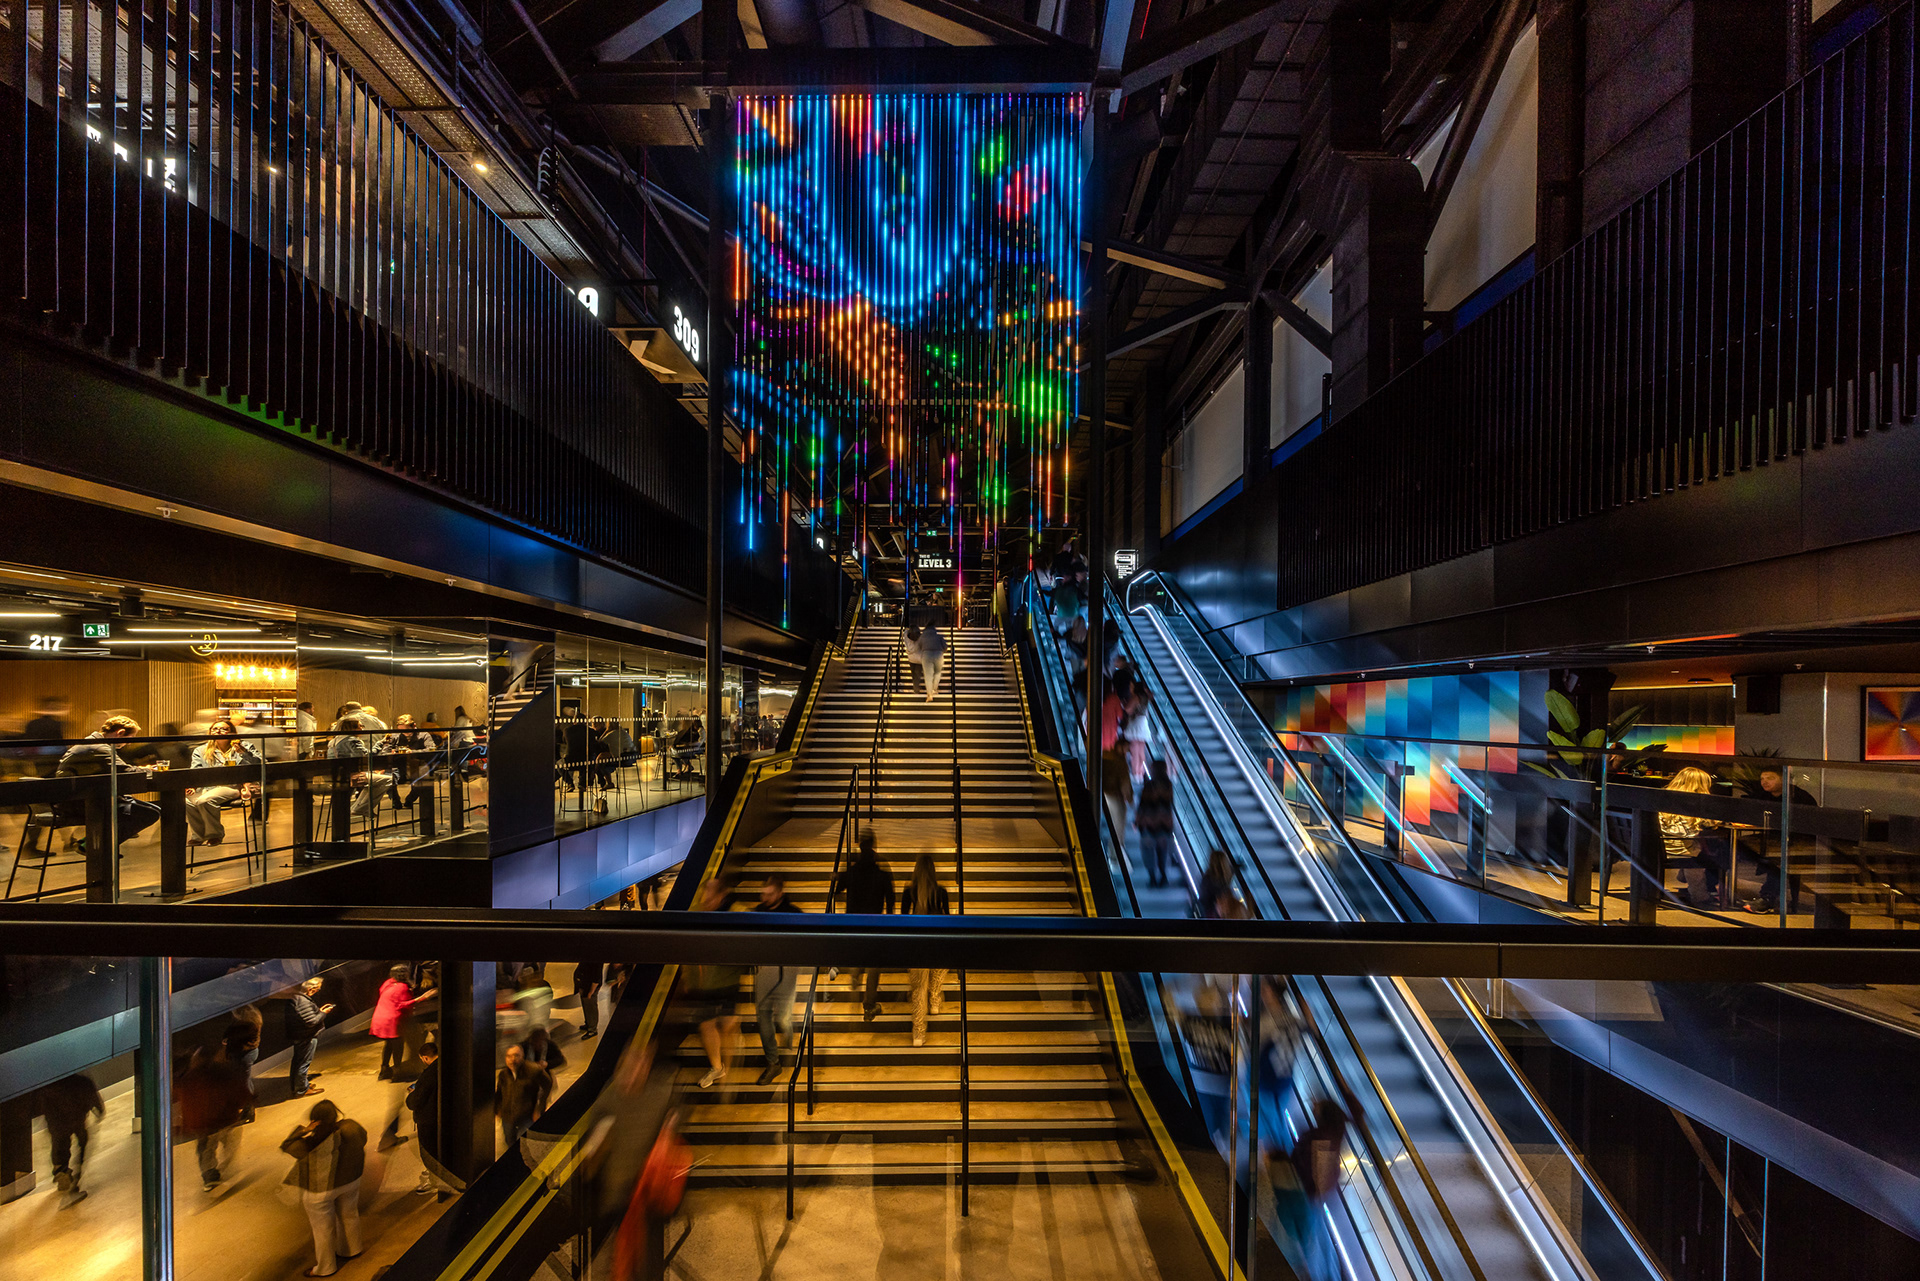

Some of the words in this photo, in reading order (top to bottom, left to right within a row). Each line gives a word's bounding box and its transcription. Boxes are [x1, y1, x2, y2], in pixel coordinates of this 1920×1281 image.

[673, 305, 700, 362] 309
[918, 559, 945, 568] LEVEL
[945, 558, 952, 568] 3
[29, 634, 63, 651] 217
